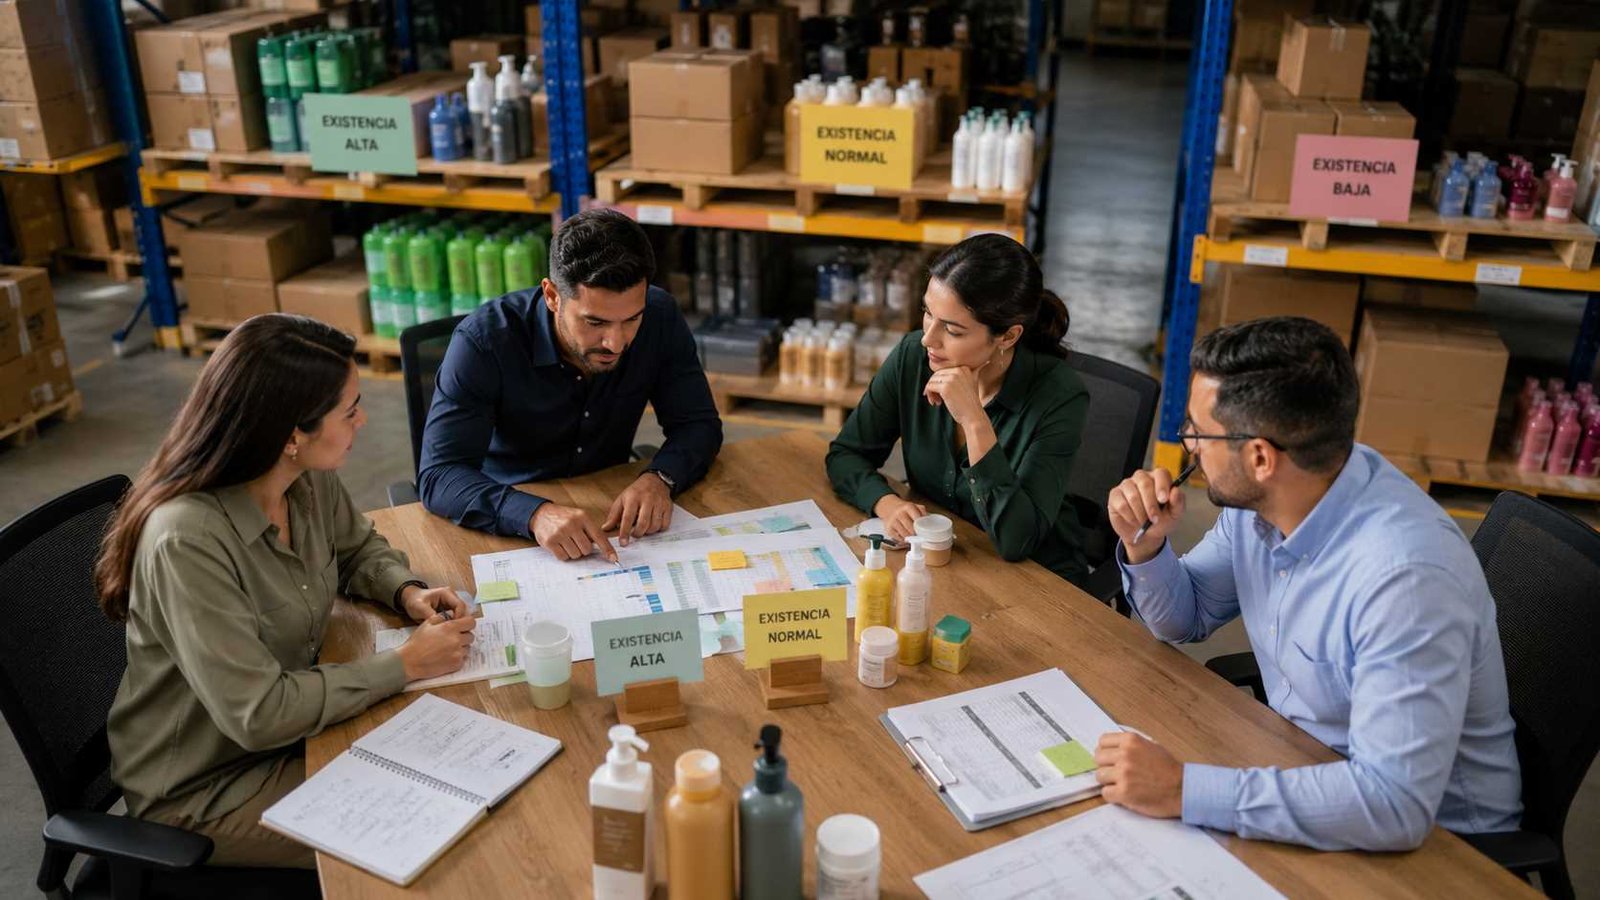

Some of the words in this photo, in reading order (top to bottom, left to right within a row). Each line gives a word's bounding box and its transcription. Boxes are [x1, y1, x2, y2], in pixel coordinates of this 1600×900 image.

[321, 114, 398, 130] EXISTENCIA
[816, 125, 897, 142] EXISTENCIA
[344, 137, 379, 152] ALTA
[824, 149, 887, 165] NORMAL
[1312, 157, 1397, 175] EXISTENCIA
[1332, 181, 1371, 197] BAJA
[758, 608, 831, 625] EXISTENCIA
[609, 630, 684, 650] EXISTENCIA
[768, 628, 823, 644] NORMAL
[630, 652, 666, 669] ALTA
